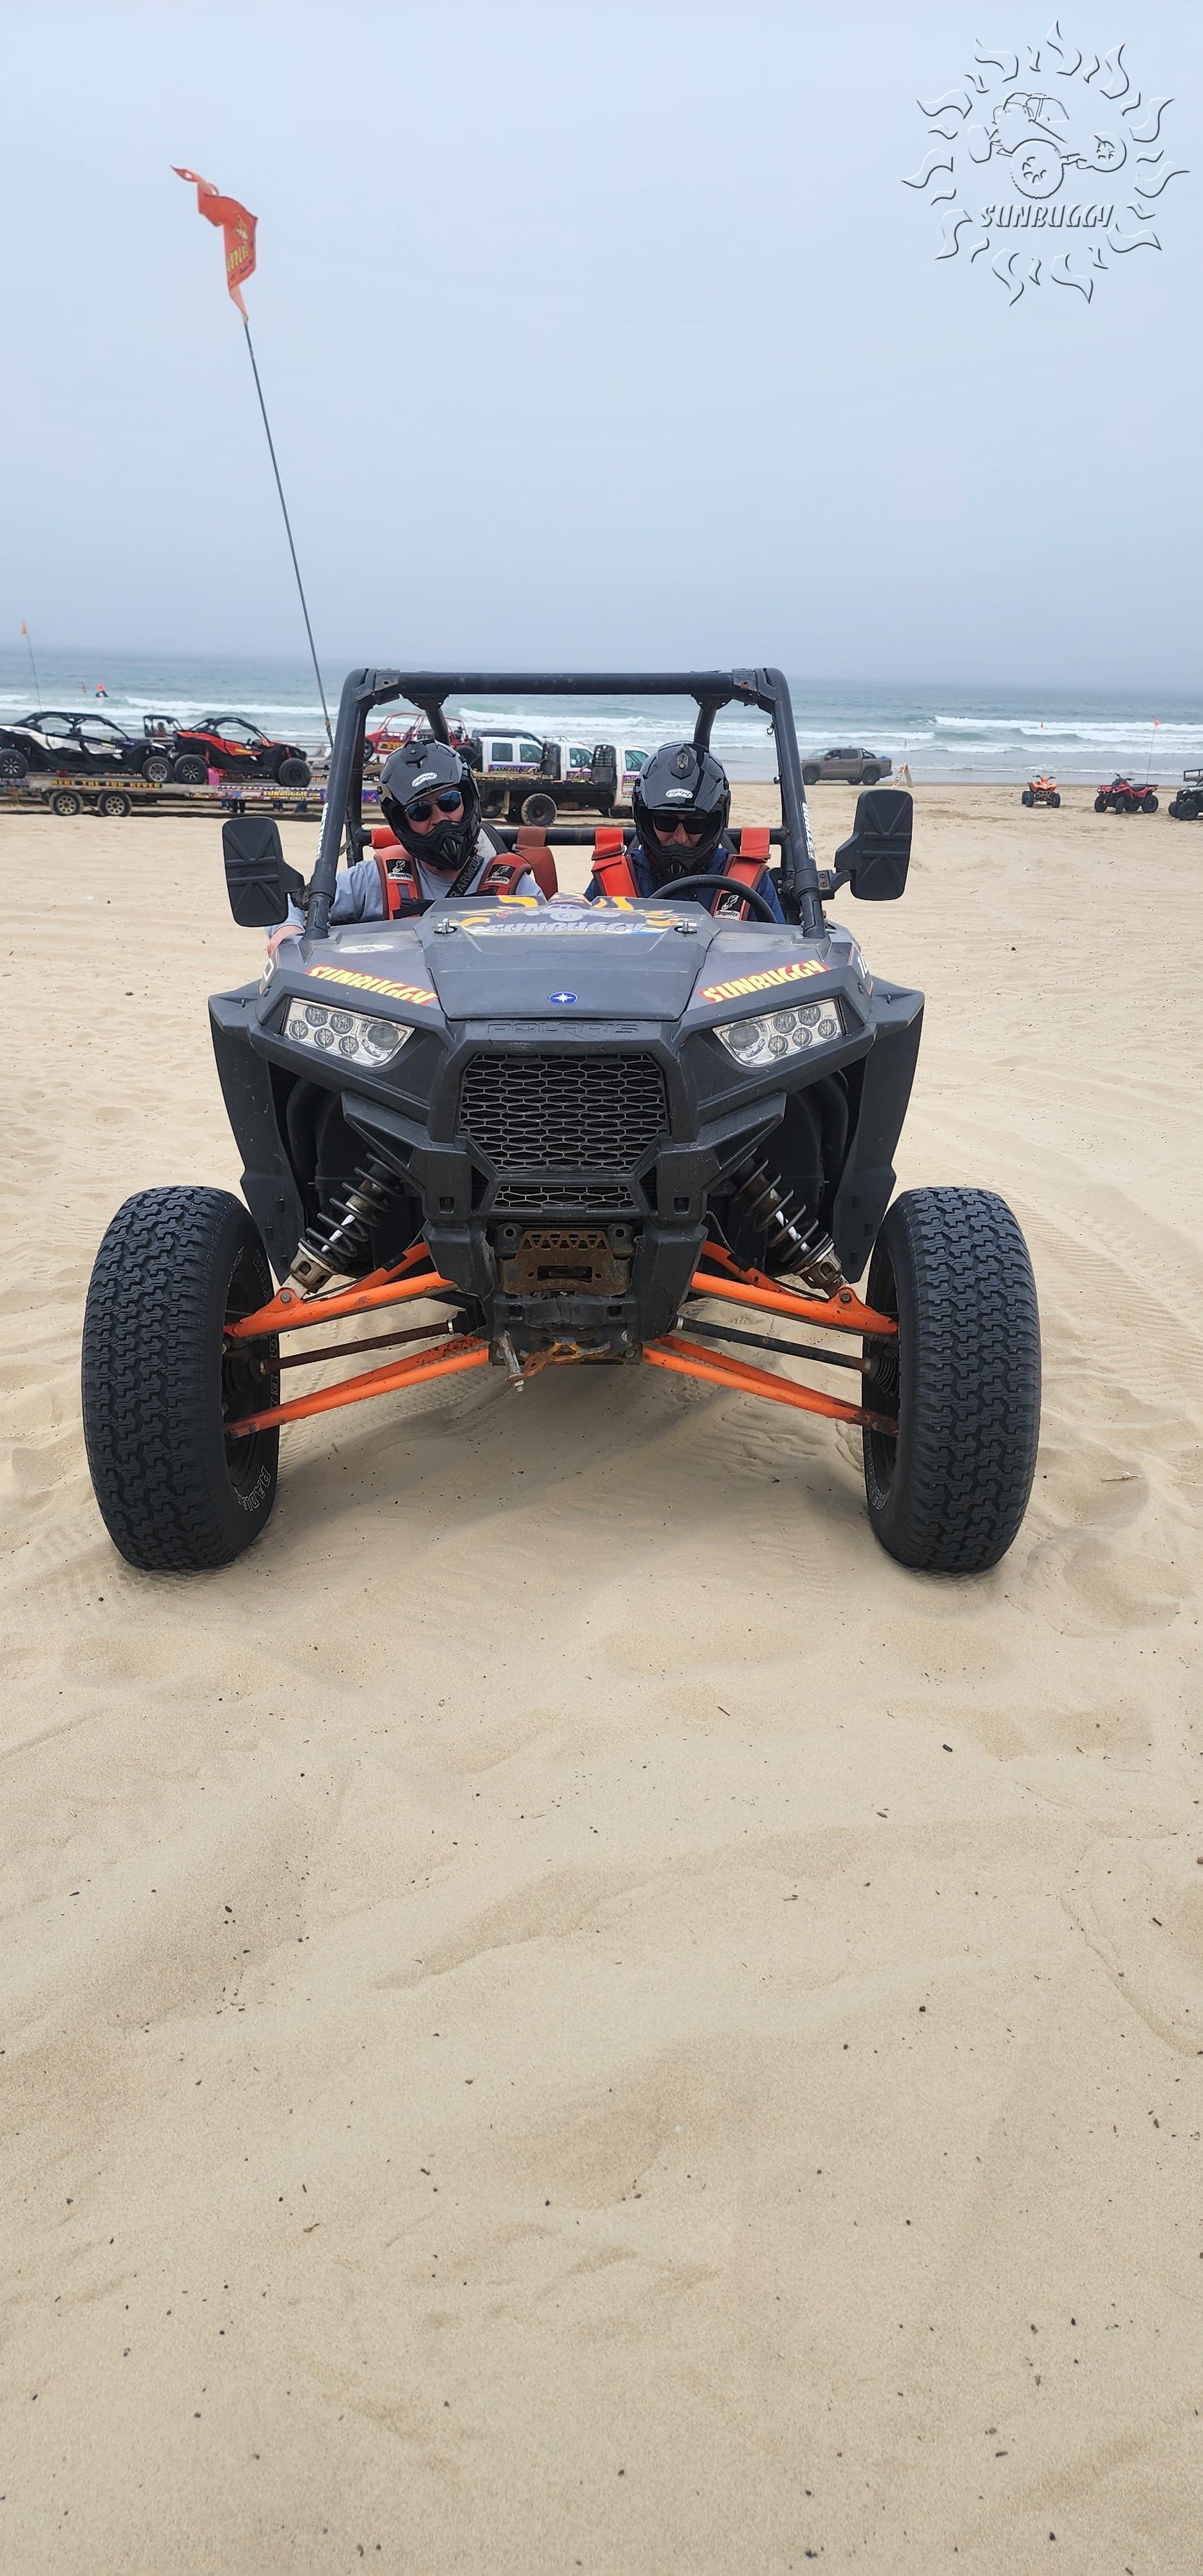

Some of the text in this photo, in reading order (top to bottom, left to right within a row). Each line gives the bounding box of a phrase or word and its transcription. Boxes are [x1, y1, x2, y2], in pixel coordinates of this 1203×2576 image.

[487, 922, 647, 933] SUNBUGGY
[308, 966, 439, 1004] SUNBUGGY
[703, 959, 827, 1003] SUNBUGGY
[487, 1021, 639, 1035] POLARIS
